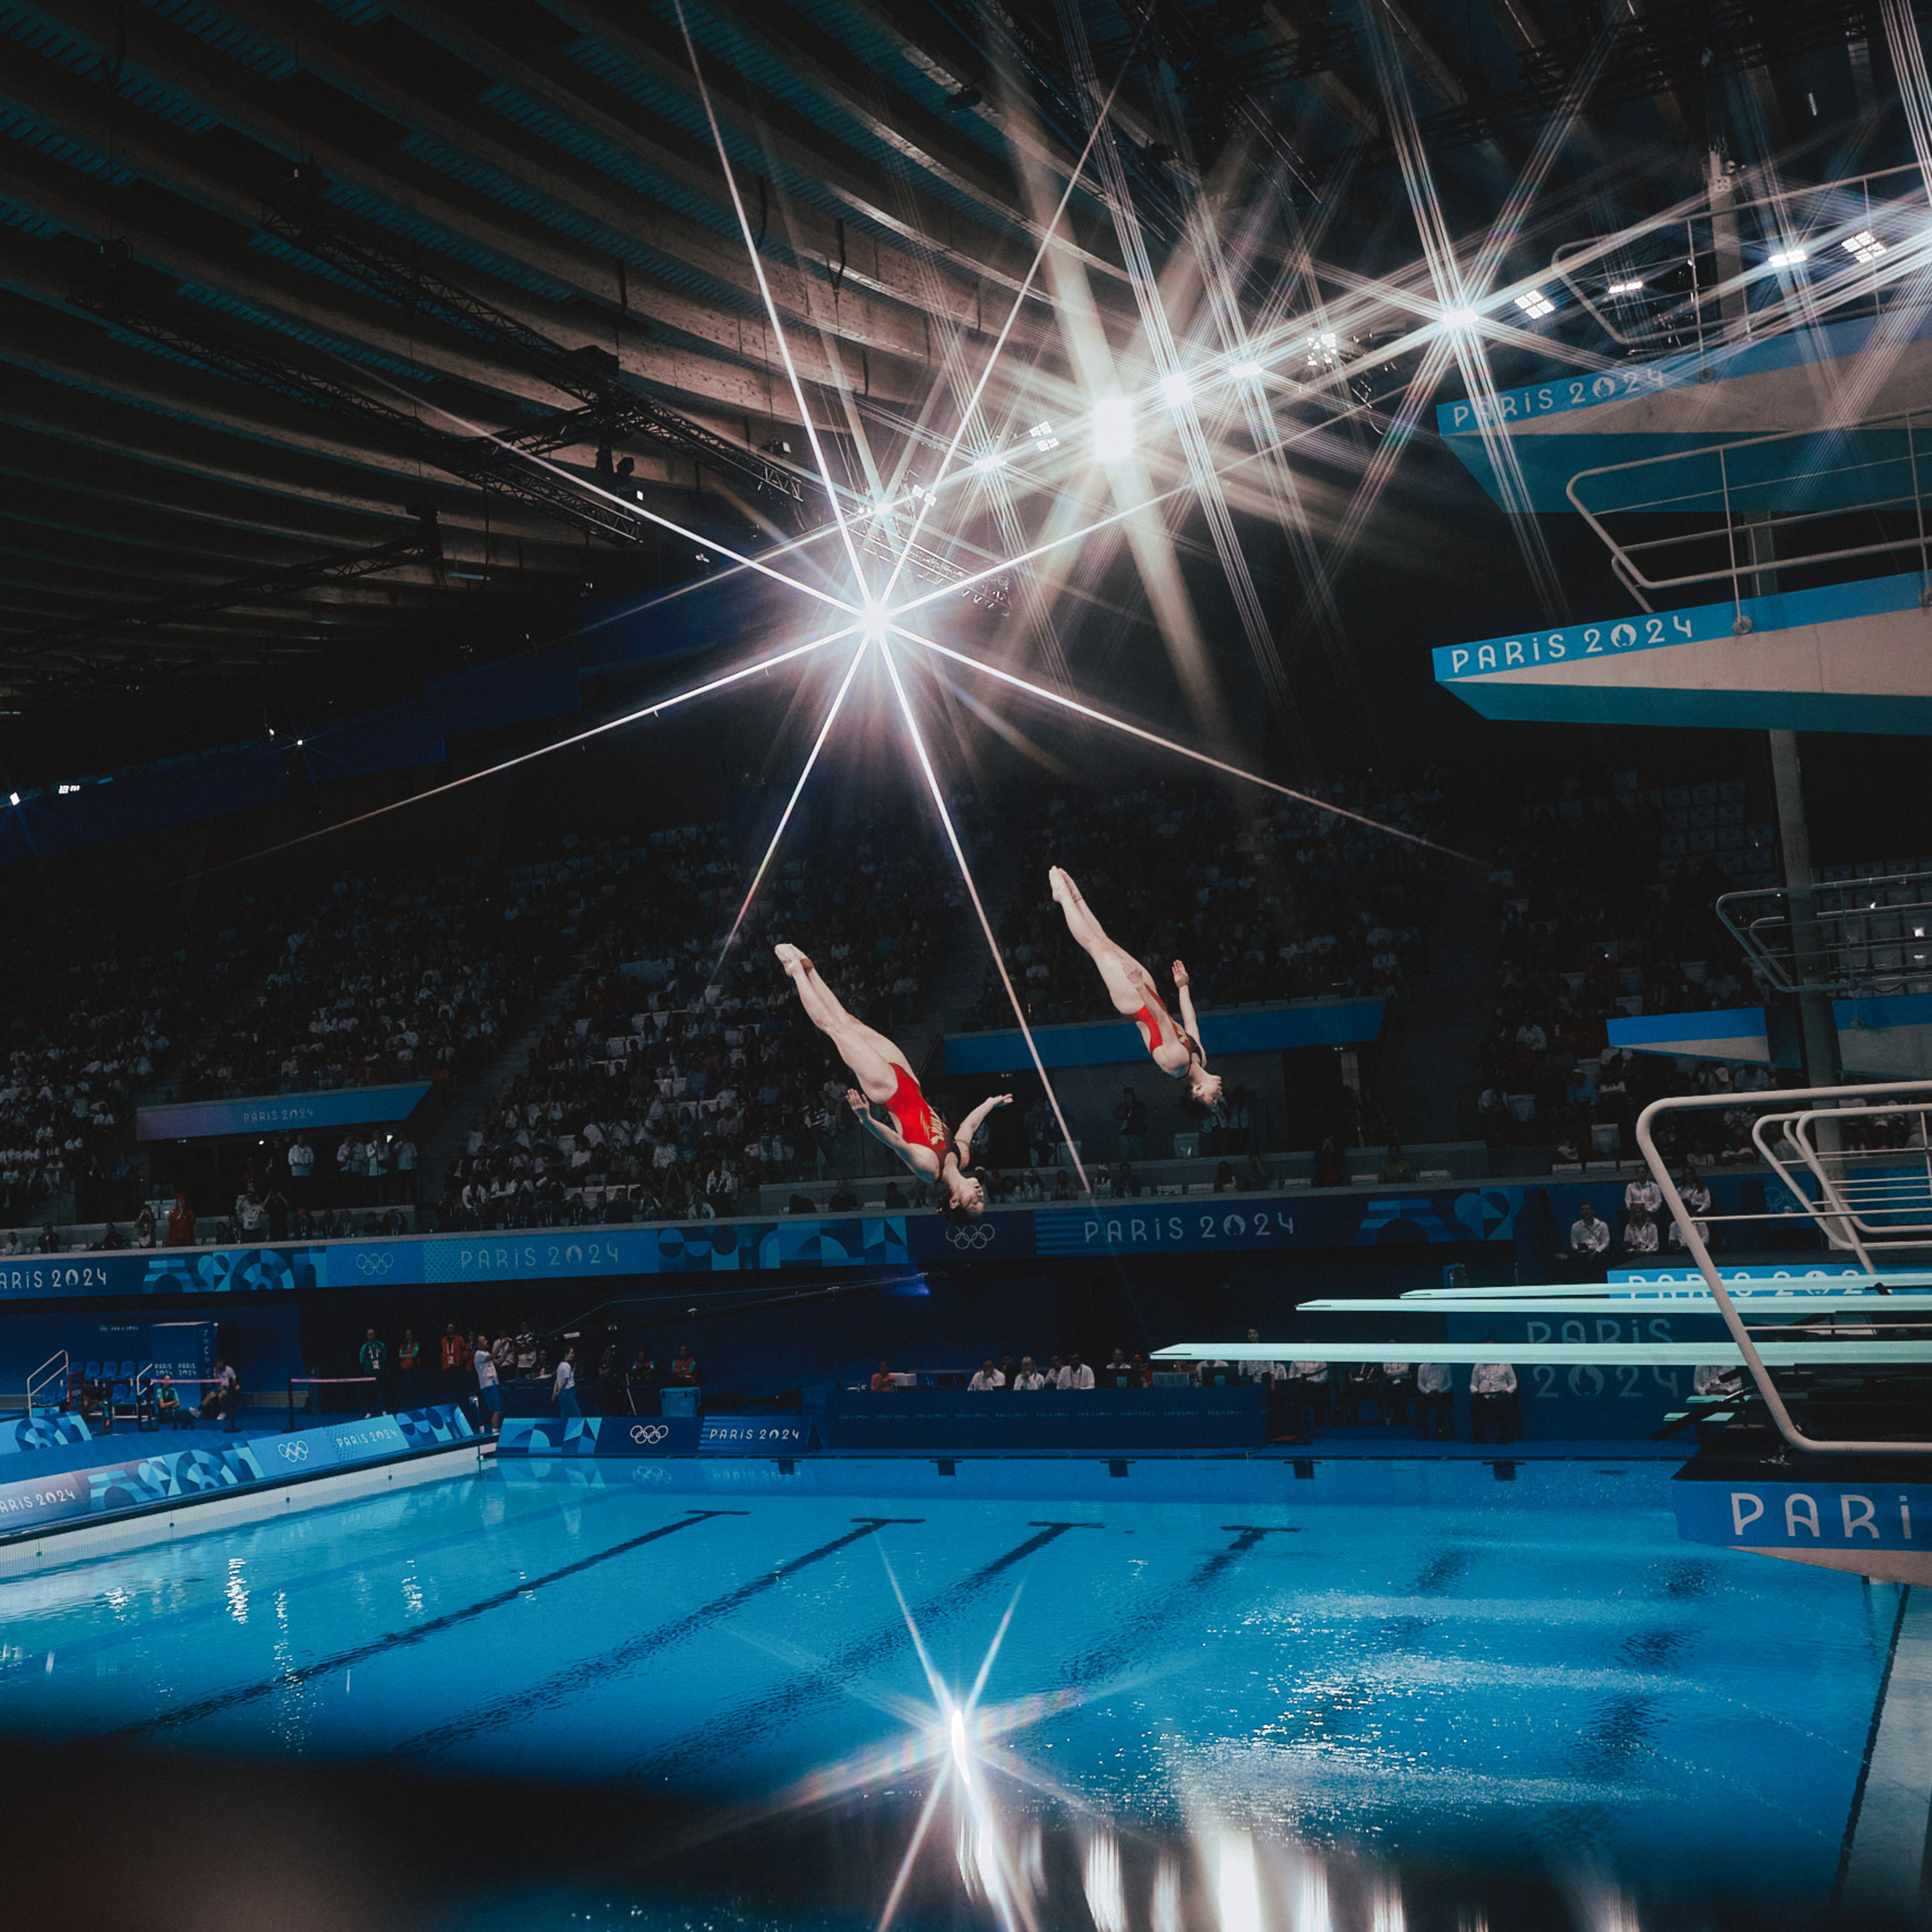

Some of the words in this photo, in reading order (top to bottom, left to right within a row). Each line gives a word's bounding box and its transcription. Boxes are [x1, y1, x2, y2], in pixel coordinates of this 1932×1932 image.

[1569, 368, 1663, 404] 2024
[1584, 616, 1692, 654] 2024
[1200, 1212, 1294, 1238] 2024
[548, 1243, 619, 1266] 2024
[52, 1267, 106, 1287] 2024
[1533, 1364, 1679, 1398] 2024
[369, 1428, 398, 1442] 2024
[759, 1428, 800, 1439] 2024
[36, 1489, 75, 1506] 2024
